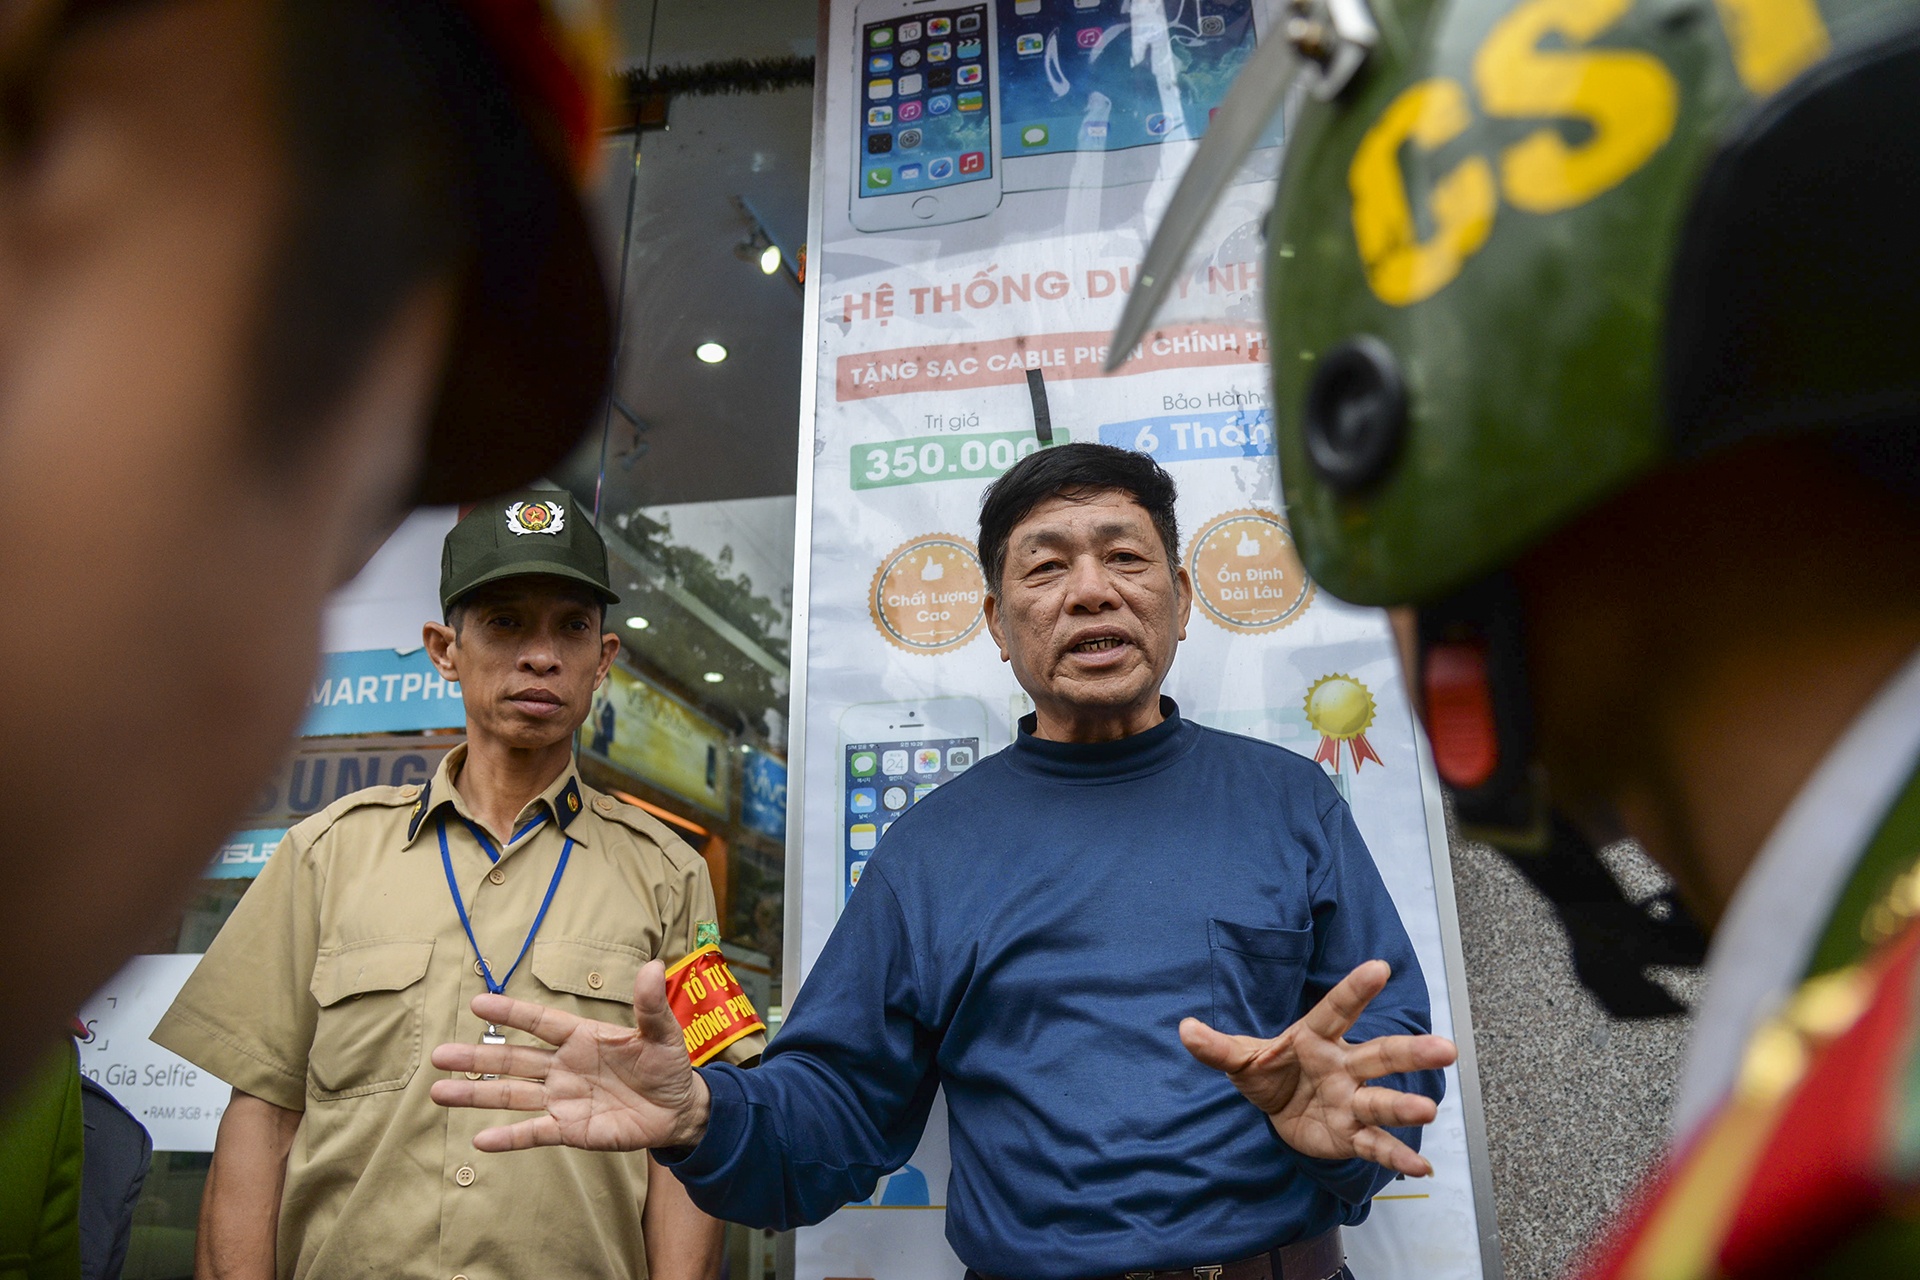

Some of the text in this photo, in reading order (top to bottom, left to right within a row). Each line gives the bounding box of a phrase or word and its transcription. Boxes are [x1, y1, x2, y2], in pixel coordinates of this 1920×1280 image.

[843, 283, 894, 326] HỆ
[909, 263, 1070, 315] THỐNG
[851, 361, 918, 390] TẶNG
[926, 356, 979, 381] SẠC
[987, 348, 1066, 371] CABLE
[1074, 342, 1143, 365] PISN
[1152, 330, 1237, 357] CHÍNH
[1163, 390, 1261, 411] Bảo Hành
[924, 412, 980, 431] Trị giá
[1134, 425, 1159, 453] 6
[1217, 563, 1283, 585] Ổn Định
[888, 590, 979, 607] Chất Lượng
[1221, 585, 1283, 600] Dài Lâu
[916, 610, 950, 622] Cao
[681, 966, 707, 1005] TỔ
[702, 963, 729, 992] TỰ
[106, 1063, 137, 1086] Gia
[142, 1063, 197, 1087] Selfie
[149, 1106, 176, 1119] RAM
